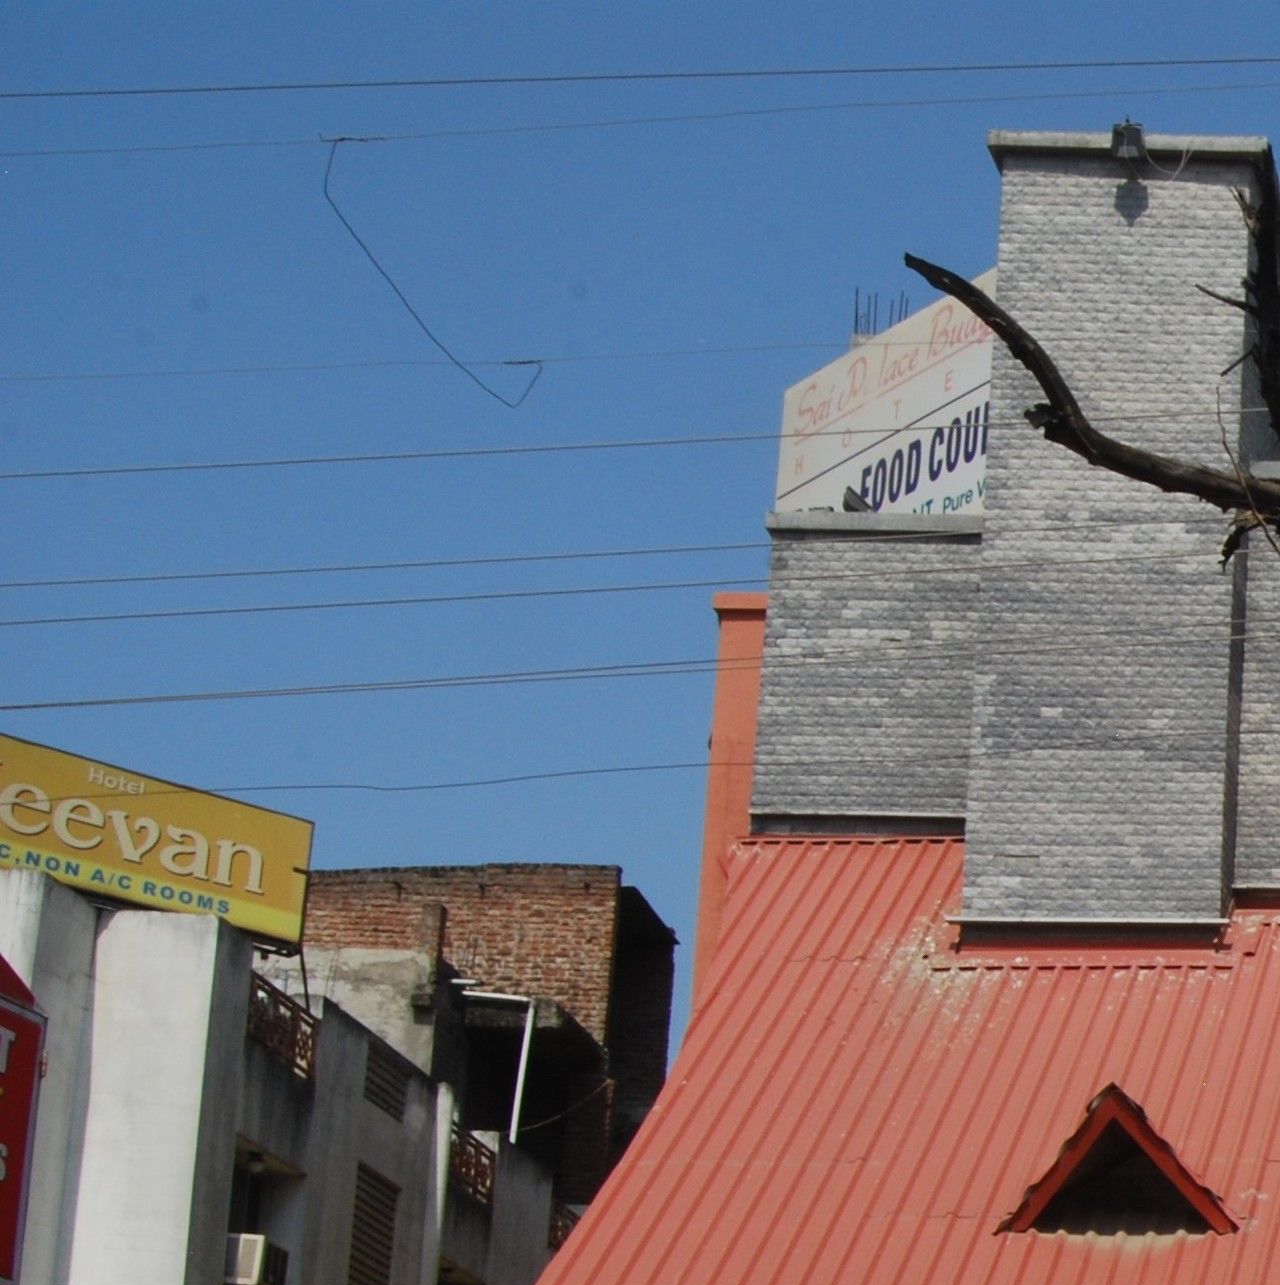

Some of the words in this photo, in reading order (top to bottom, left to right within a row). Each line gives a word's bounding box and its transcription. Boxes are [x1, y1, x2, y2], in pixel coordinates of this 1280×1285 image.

[87, 766, 146, 796] Hotel
[90, 868, 132, 891] A/C
[142, 880, 231, 915] ROOMS
